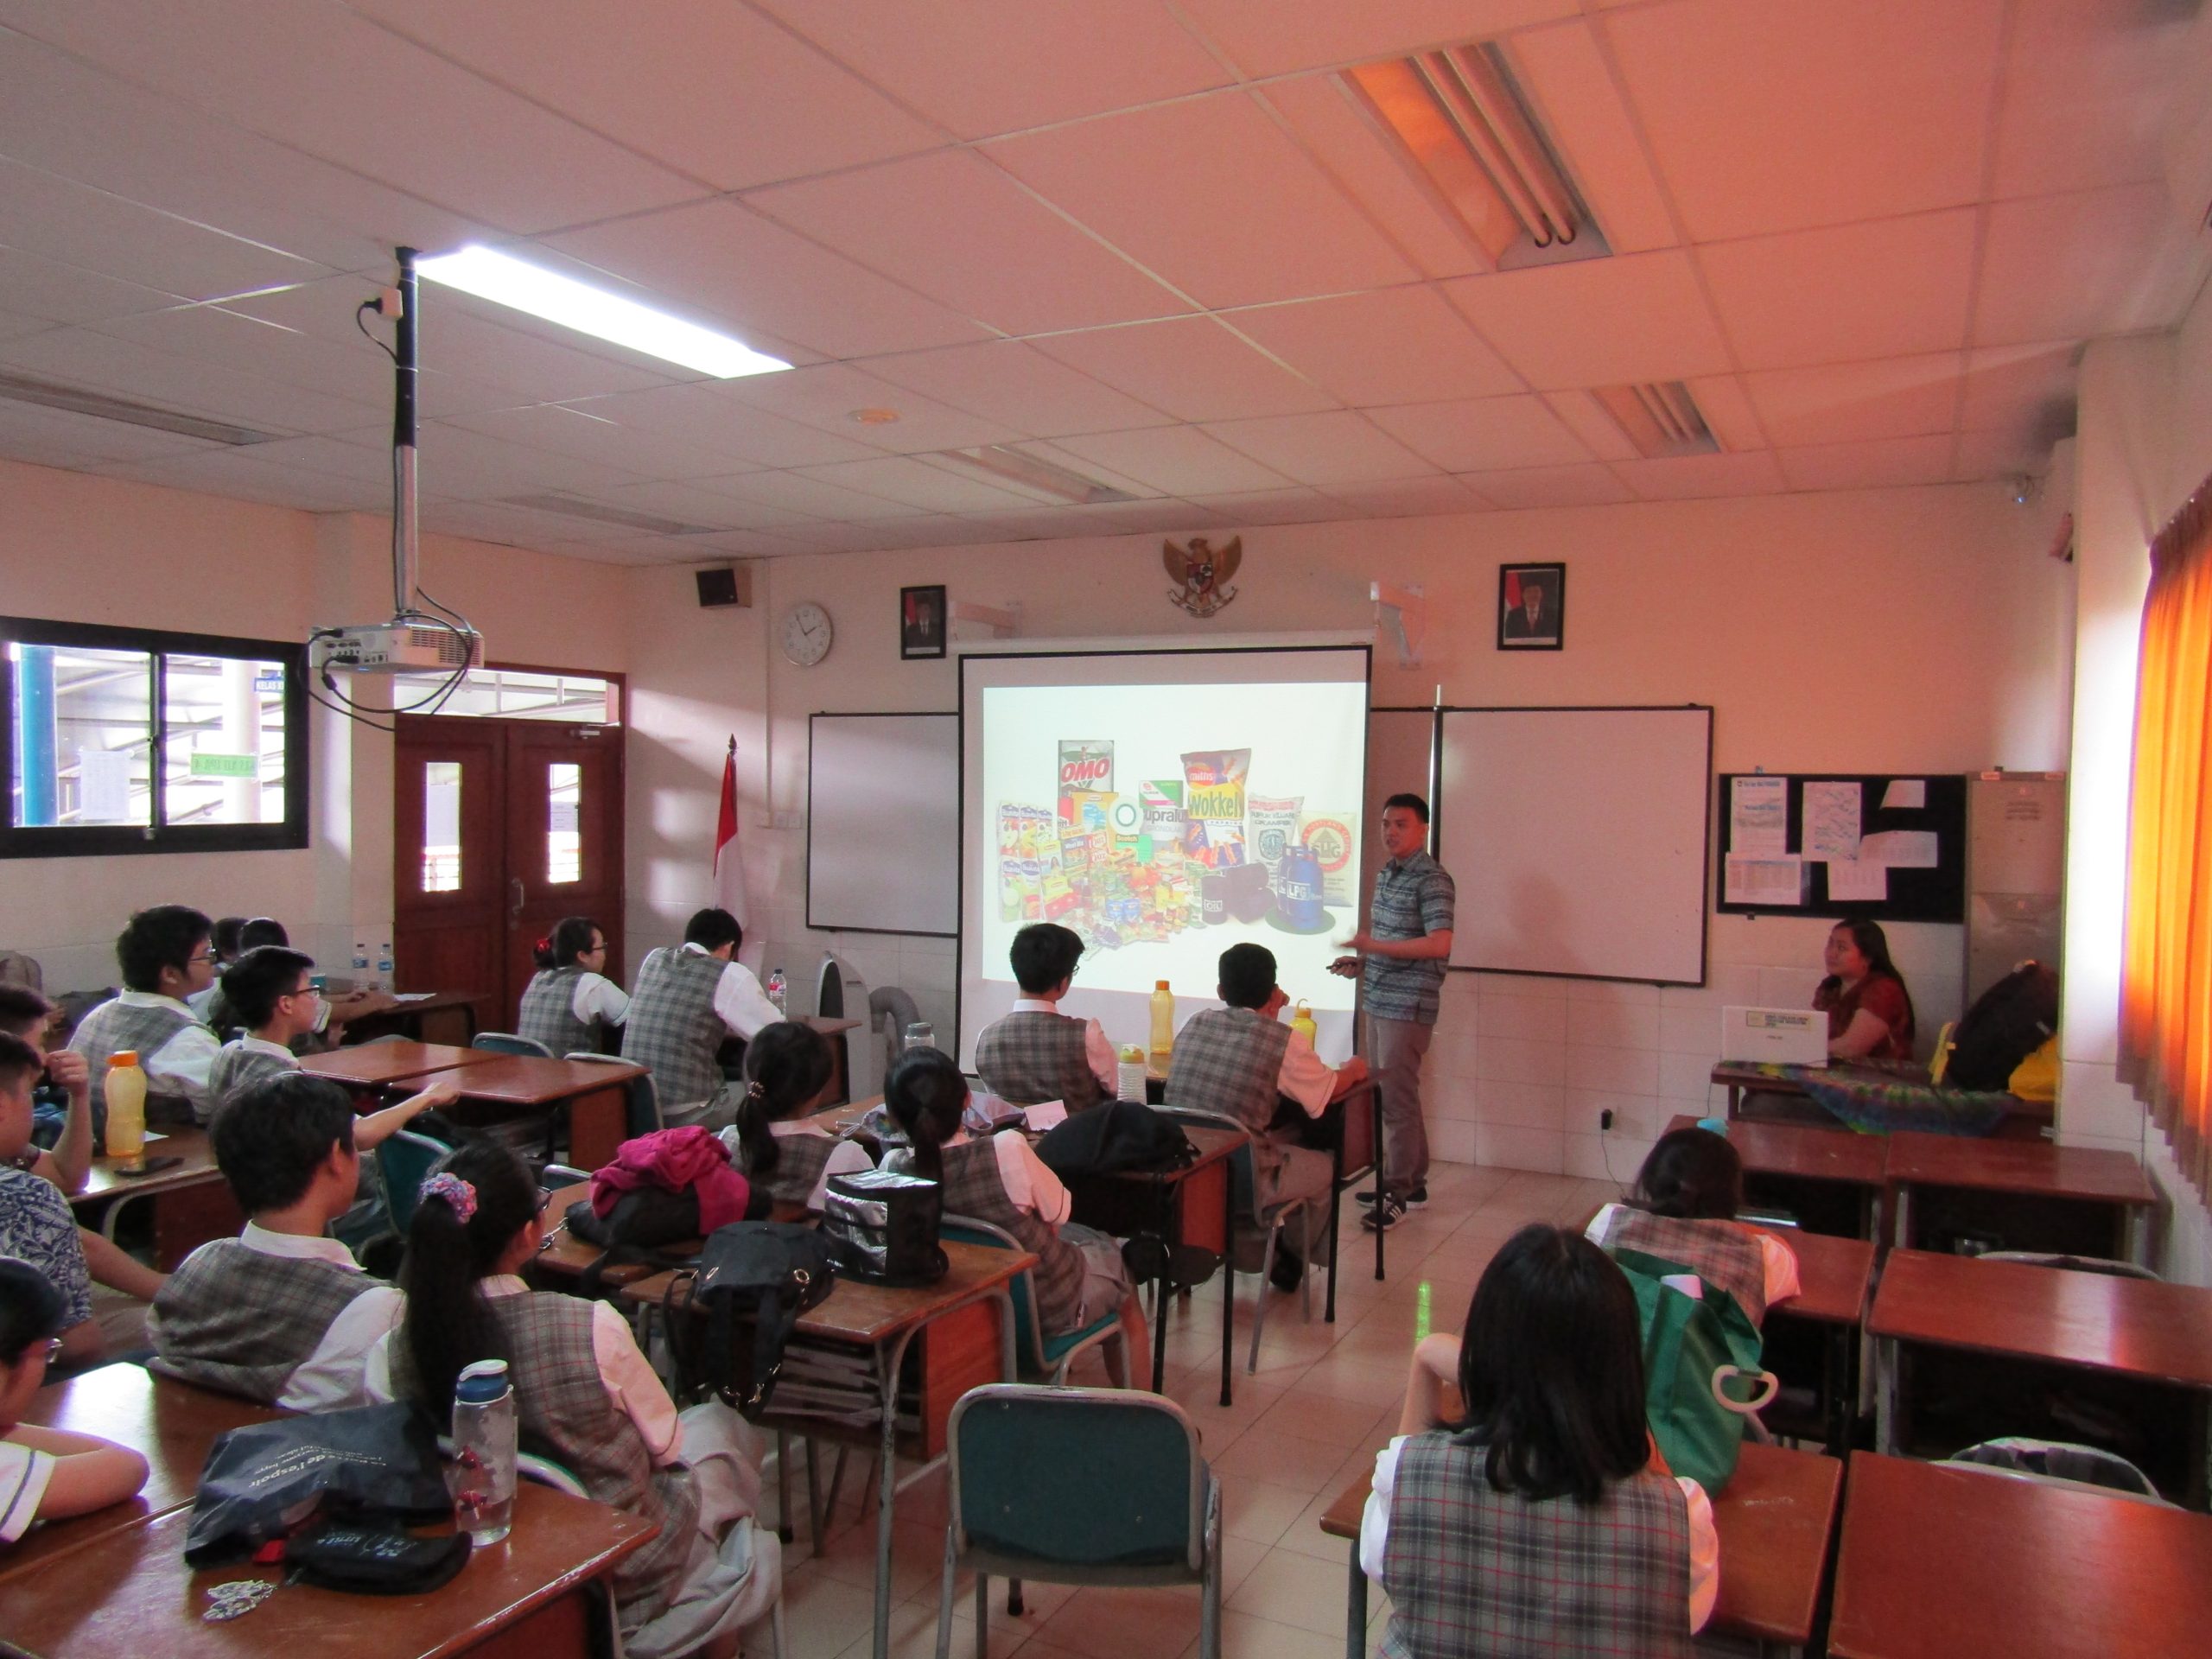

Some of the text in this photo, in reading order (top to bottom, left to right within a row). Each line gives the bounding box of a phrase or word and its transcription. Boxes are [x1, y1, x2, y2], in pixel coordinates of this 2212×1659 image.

[1061, 758, 1111, 784] OMO
[1188, 772, 1214, 782] miths
[1116, 833, 1138, 842] Scotch
[1288, 885, 1307, 898] LPG
[1205, 901, 1220, 910] OIL
[307, 1454, 325, 1465] de
[248, 1461, 305, 1488] l'espoir
